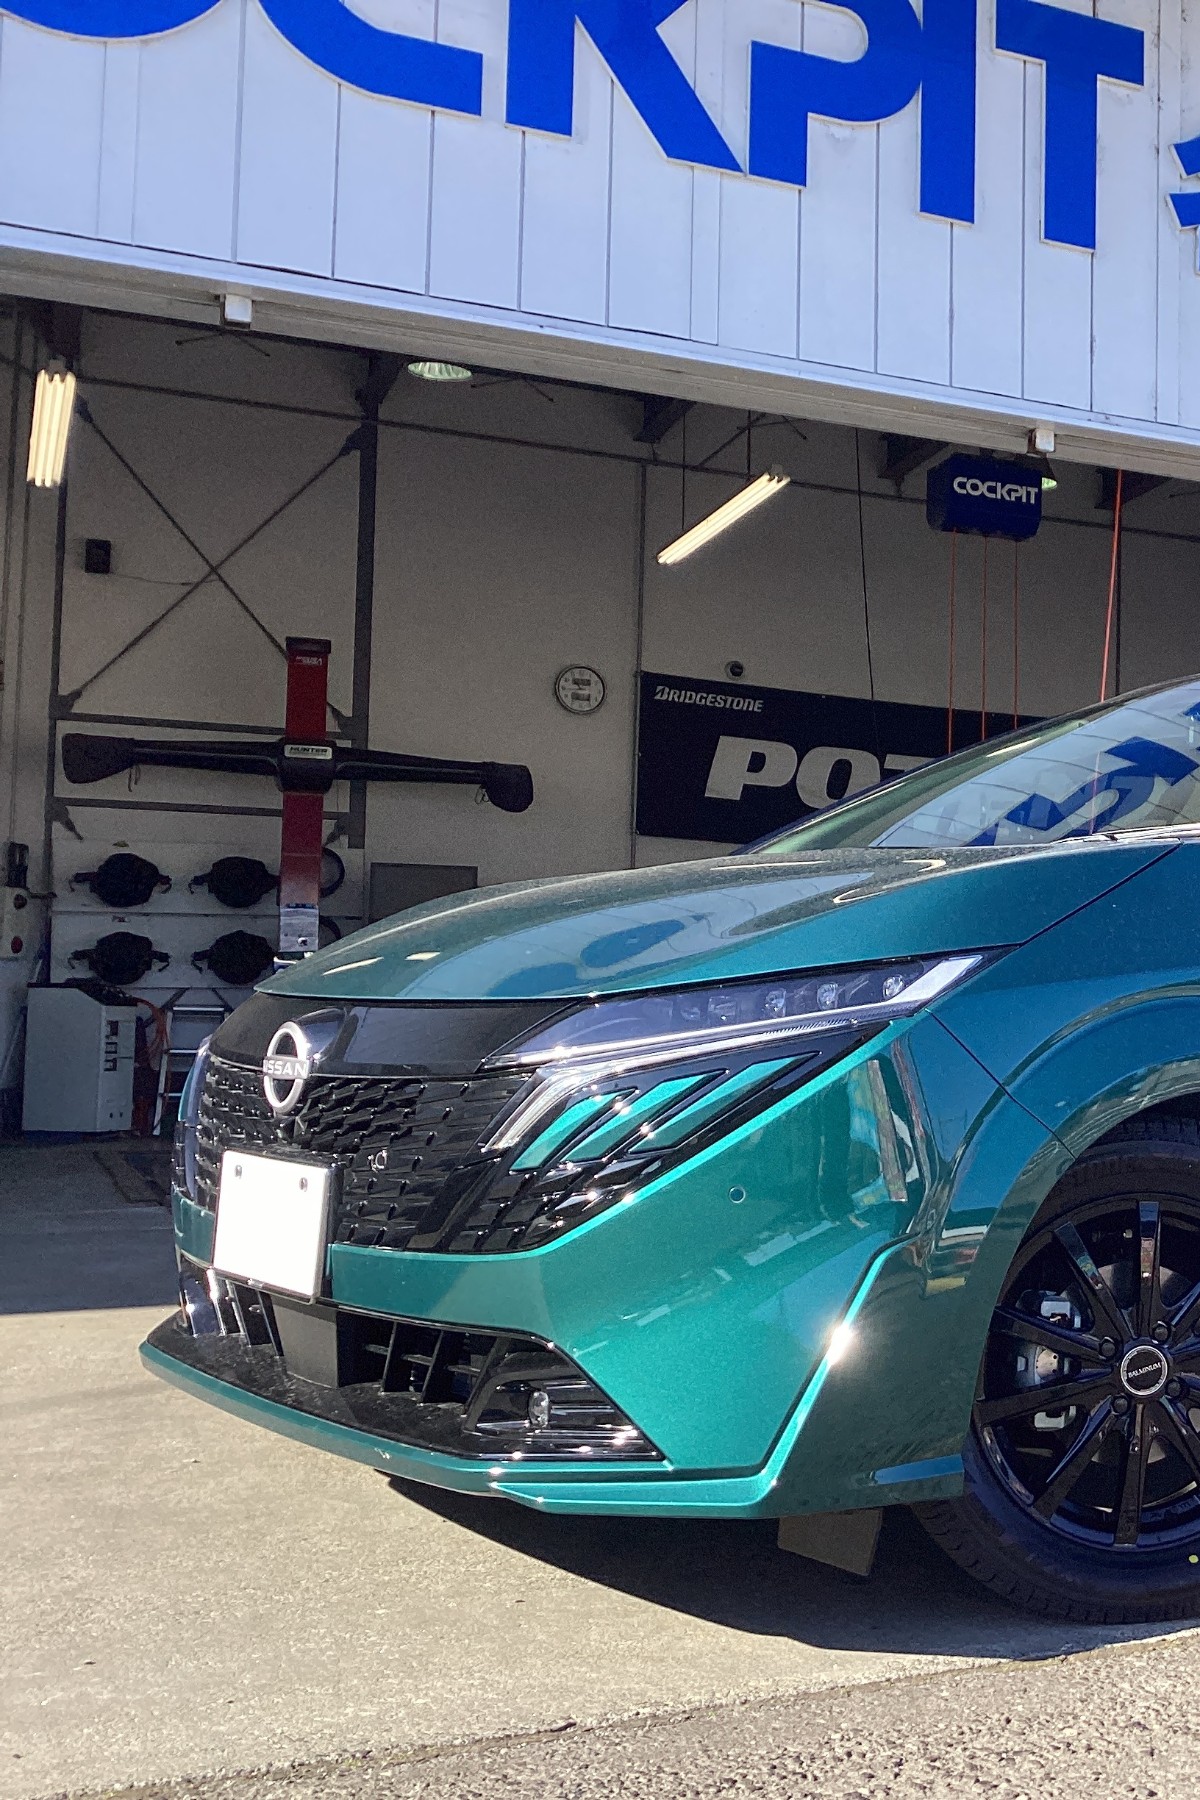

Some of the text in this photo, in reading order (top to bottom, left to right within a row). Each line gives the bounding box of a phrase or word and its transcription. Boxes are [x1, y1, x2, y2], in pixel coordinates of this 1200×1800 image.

[0, 0, 1145, 254] KPIT
[953, 476, 1039, 505] COCKPIT
[654, 685, 764, 713] BRIDGESTONE
[263, 1058, 308, 1077] ISSAN
